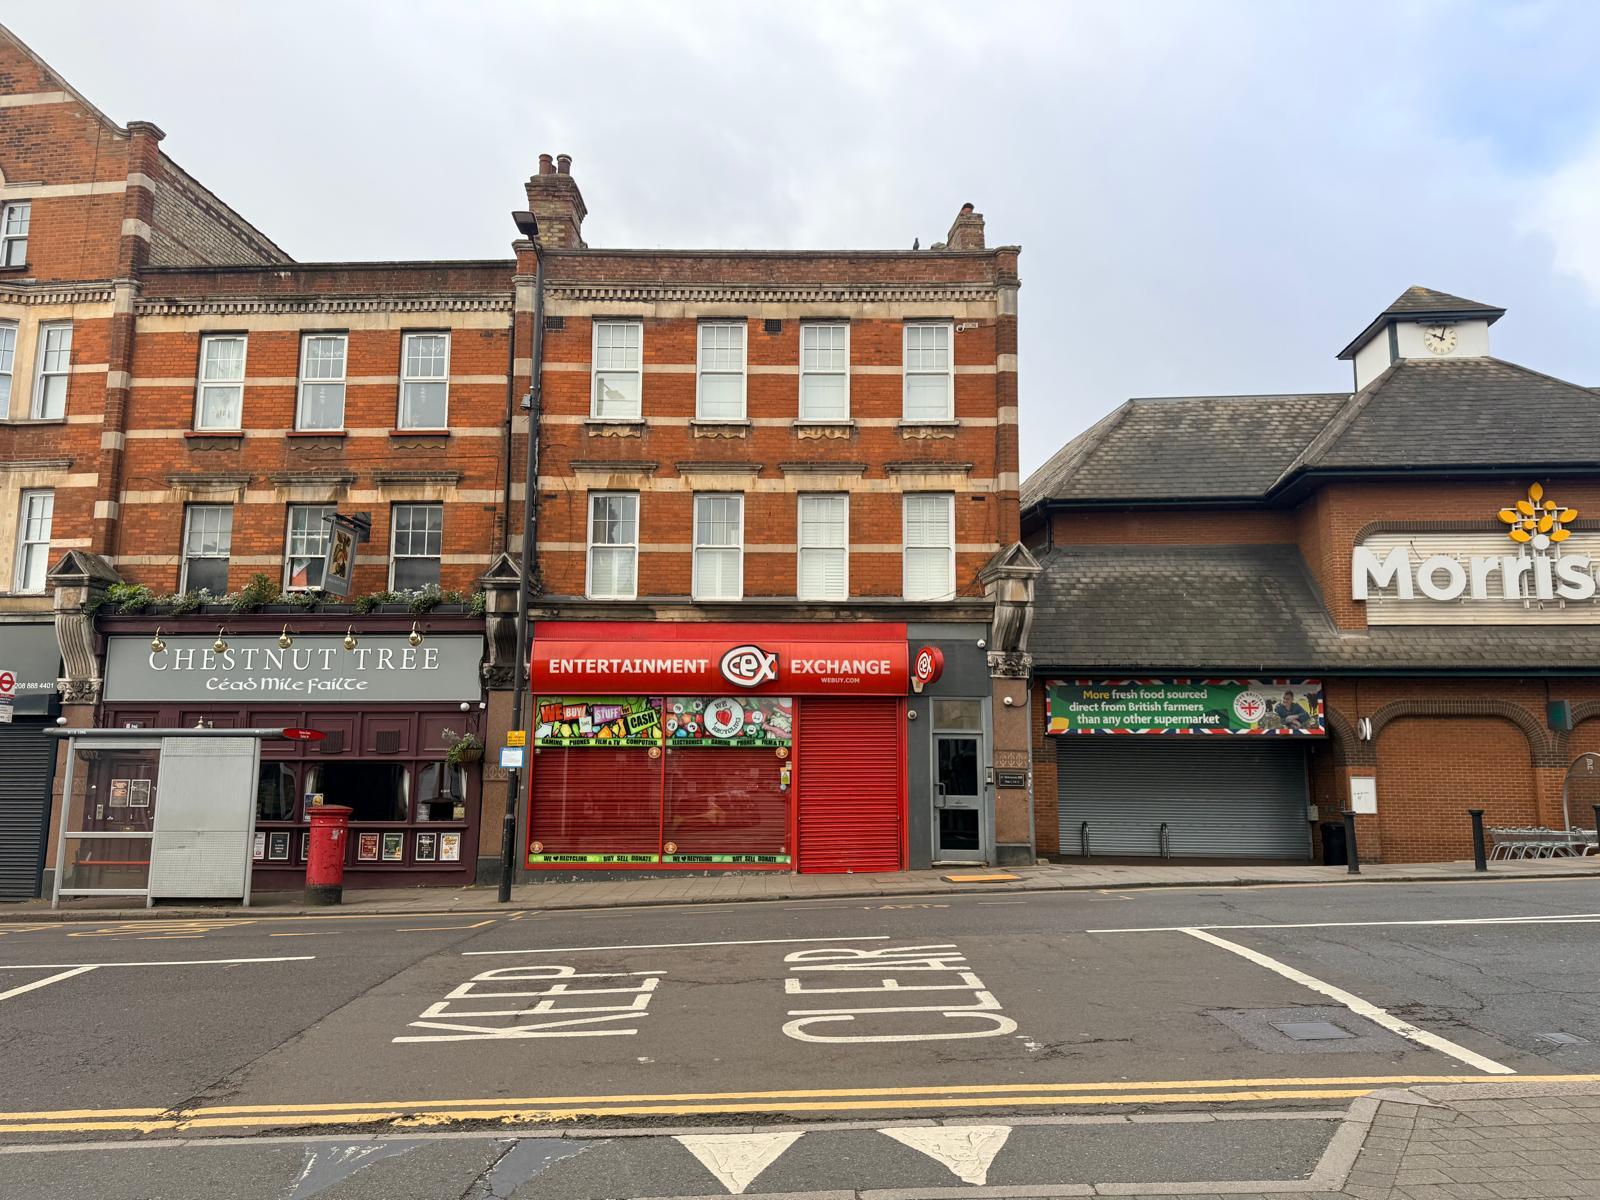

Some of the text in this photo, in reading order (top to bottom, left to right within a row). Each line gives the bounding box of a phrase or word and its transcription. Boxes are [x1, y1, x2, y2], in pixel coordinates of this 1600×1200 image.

[1352, 546, 1600, 600] Morris
[149, 647, 440, 671] CHESTNUT TREE
[549, 658, 709, 674] ENTERTAINMENT
[791, 659, 891, 675] EXCHANGE
[820, 676, 860, 684] WEBUY.COM
[1083, 689, 1208, 699] More fresh food sourced
[1069, 702, 1204, 712] direct from British farmers
[541, 704, 564, 723] WE
[565, 707, 581, 718] BUY
[594, 707, 619, 720] STUFF
[630, 712, 655, 729] CASH
[1077, 713, 1220, 726] than any other supermarket
[782, 944, 1018, 1043] CLEAR
[391, 965, 667, 1043] KEEP
